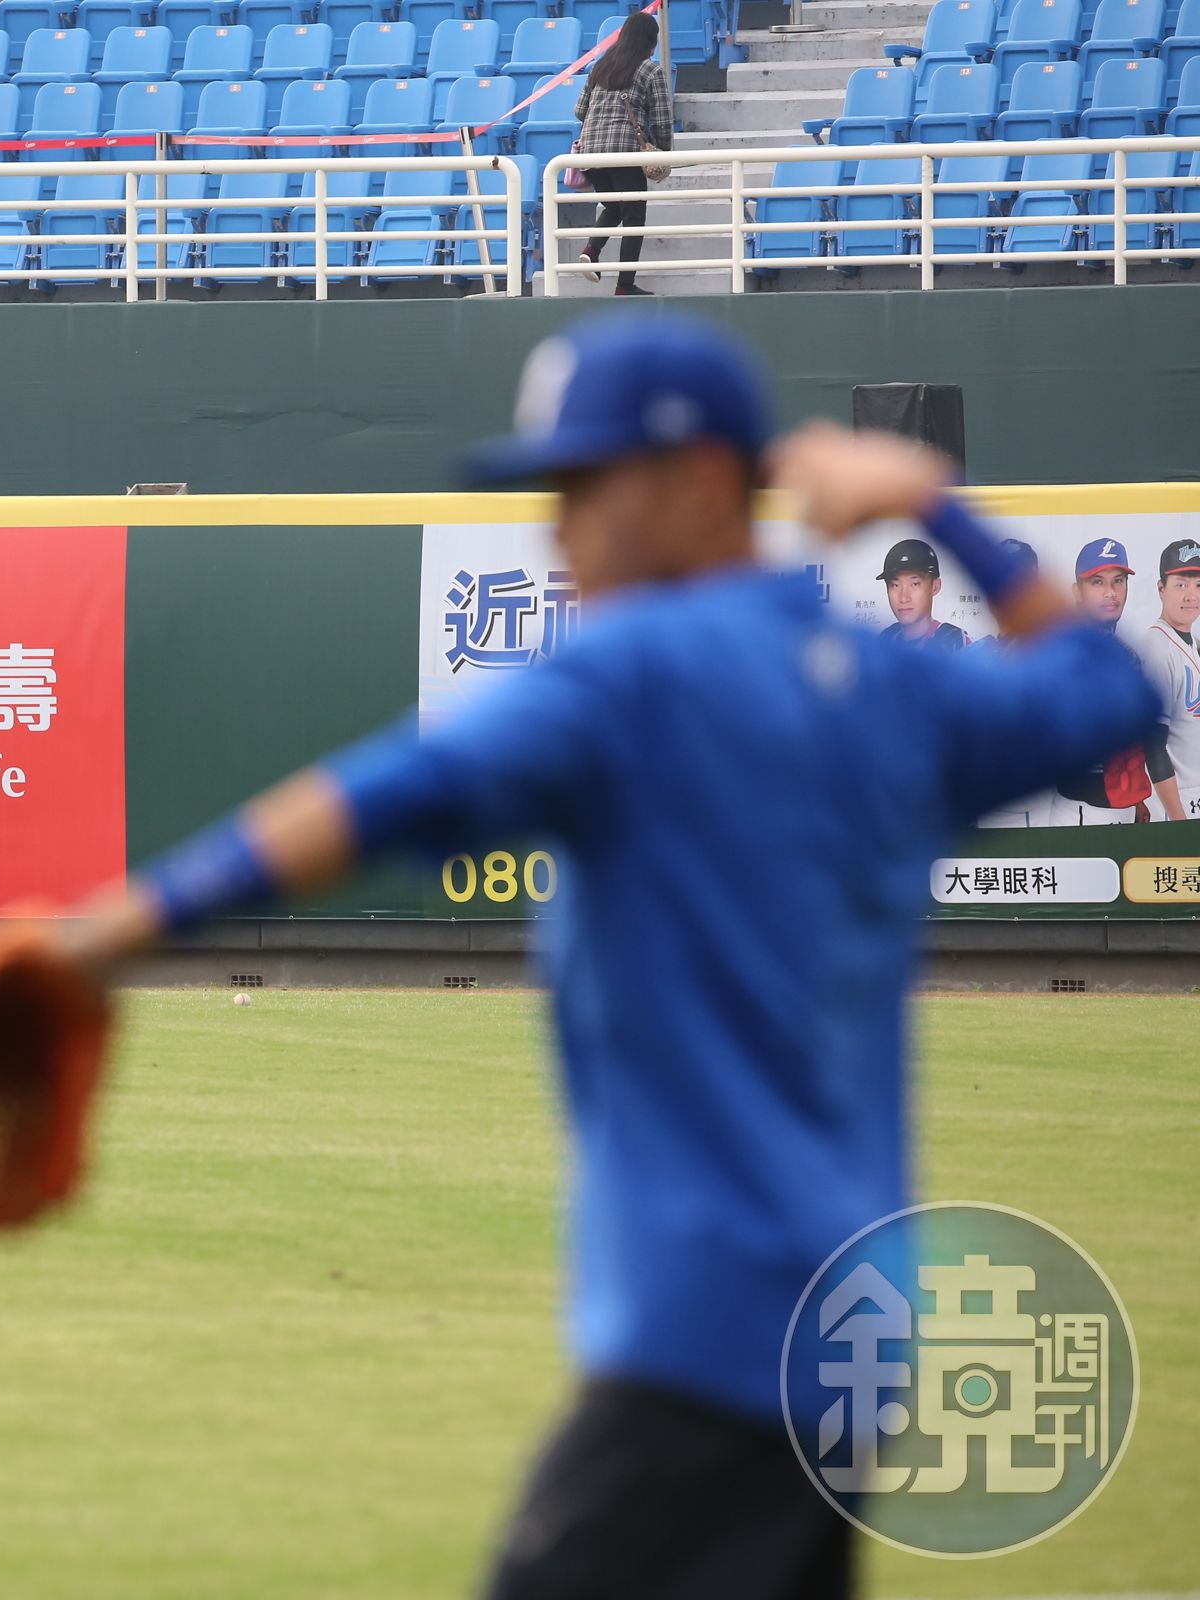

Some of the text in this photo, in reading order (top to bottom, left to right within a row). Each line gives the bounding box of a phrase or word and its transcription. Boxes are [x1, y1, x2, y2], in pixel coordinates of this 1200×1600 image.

[442, 850, 558, 903] 080
[945, 866, 1058, 895] 大學眼科
